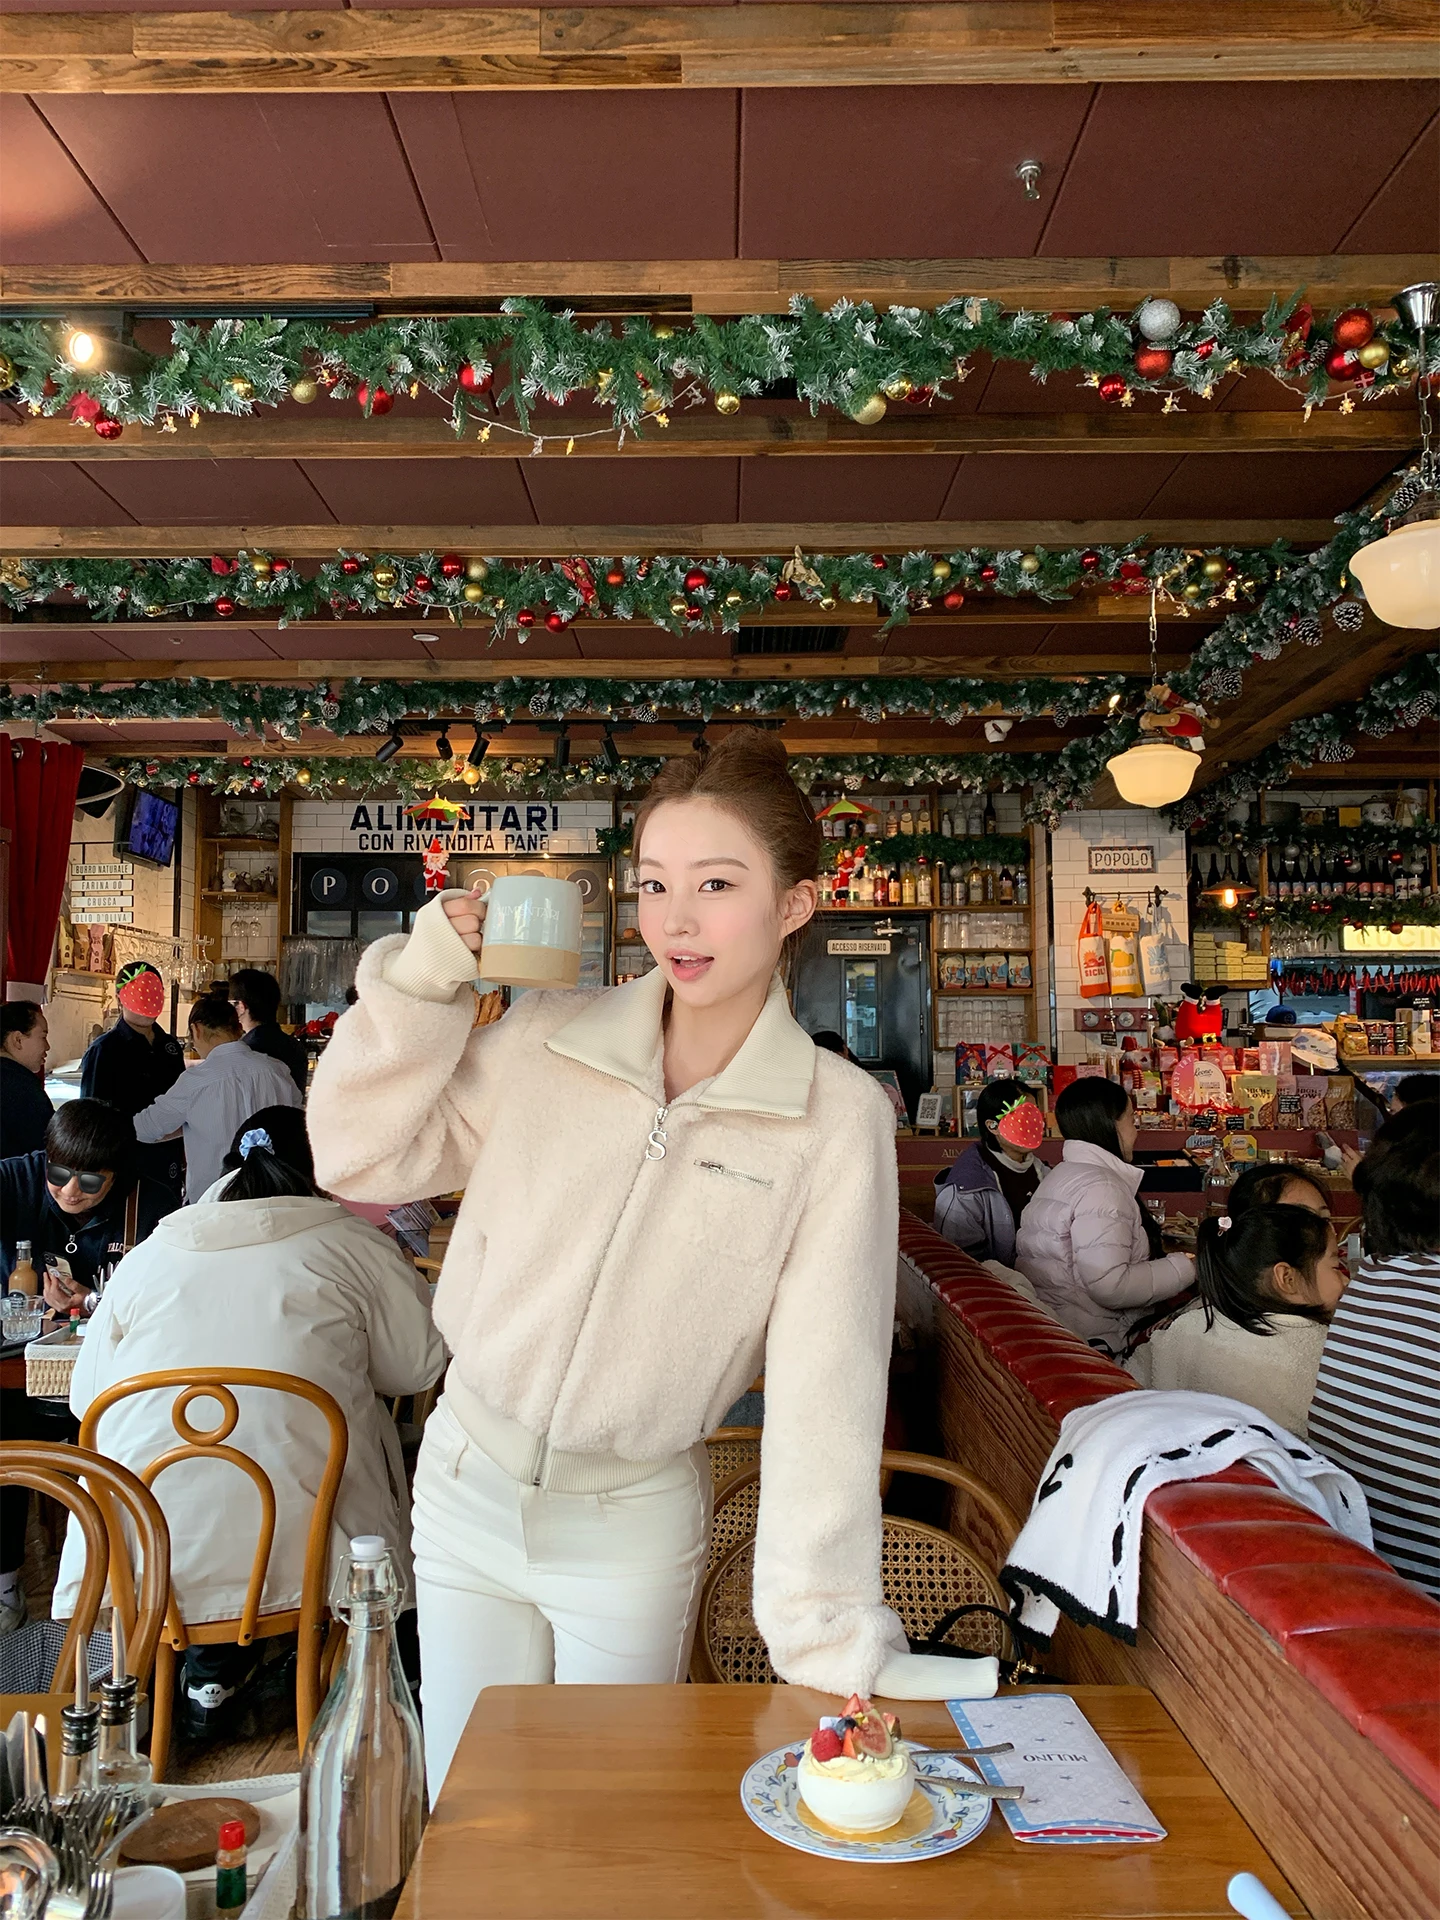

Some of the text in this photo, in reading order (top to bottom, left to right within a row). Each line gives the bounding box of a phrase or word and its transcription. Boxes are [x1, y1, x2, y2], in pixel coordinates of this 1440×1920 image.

[358, 833, 549, 851] CON RIVENDITA PANE
[1094, 852, 1149, 867] POPOLO
[75, 865, 128, 874] BURRO NATURALE
[81, 881, 109, 890] FARINA
[87, 897, 117, 906] CRUSCA
[75, 913, 127, 923] OLIO D'OLIVA
[831, 942, 887, 952] ACCESSO RISERVATO
[1022, 1752, 1089, 1764] MULINO
